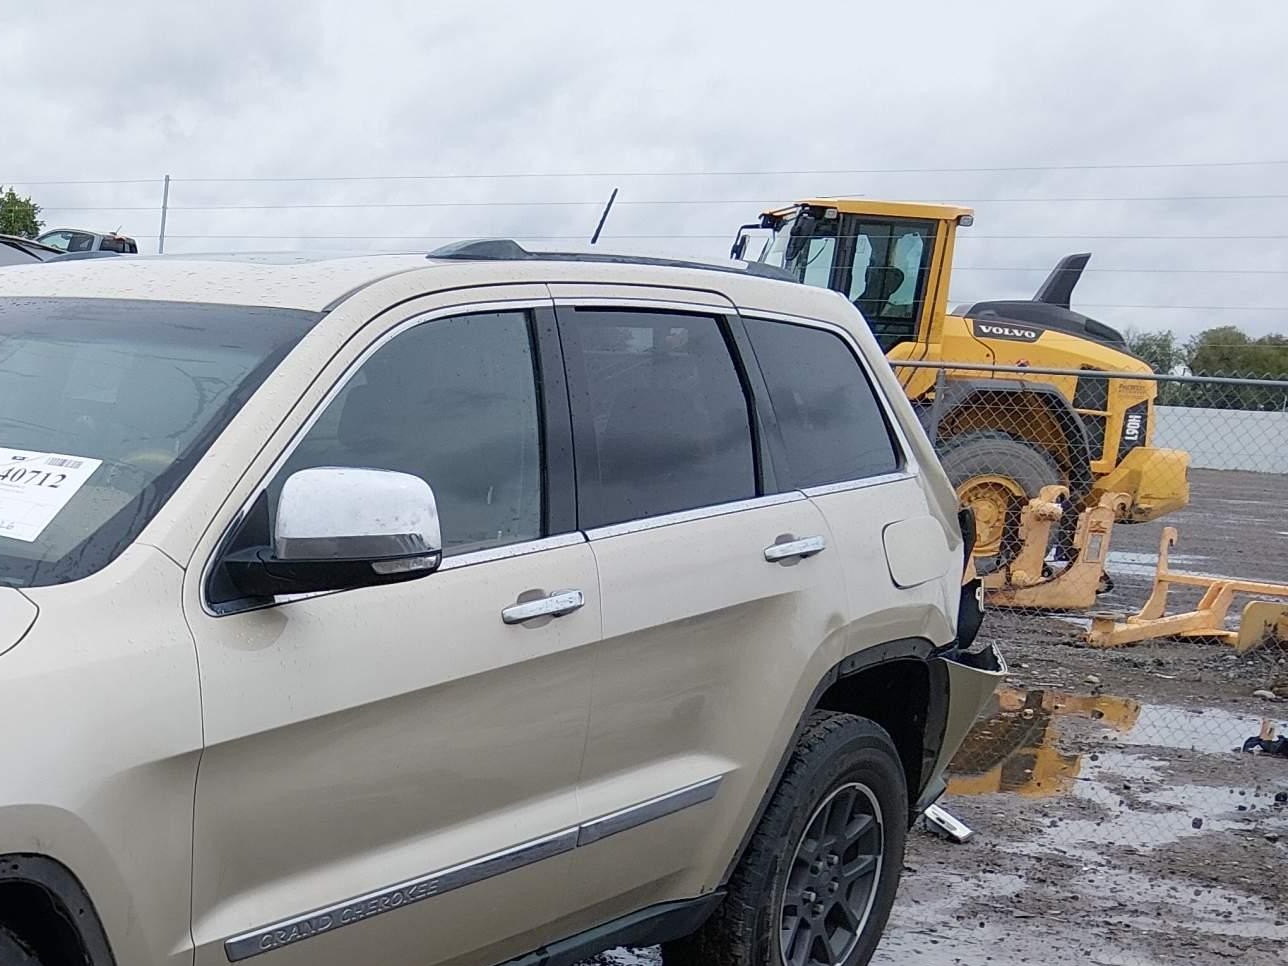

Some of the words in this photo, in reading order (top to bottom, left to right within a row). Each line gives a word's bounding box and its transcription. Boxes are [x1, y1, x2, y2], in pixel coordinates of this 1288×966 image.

[978, 324, 1036, 338] VOLVO
[1124, 414, 1142, 441] L90H
[259, 916, 333, 950] GRAND
[340, 880, 439, 923] CHEROKEE
